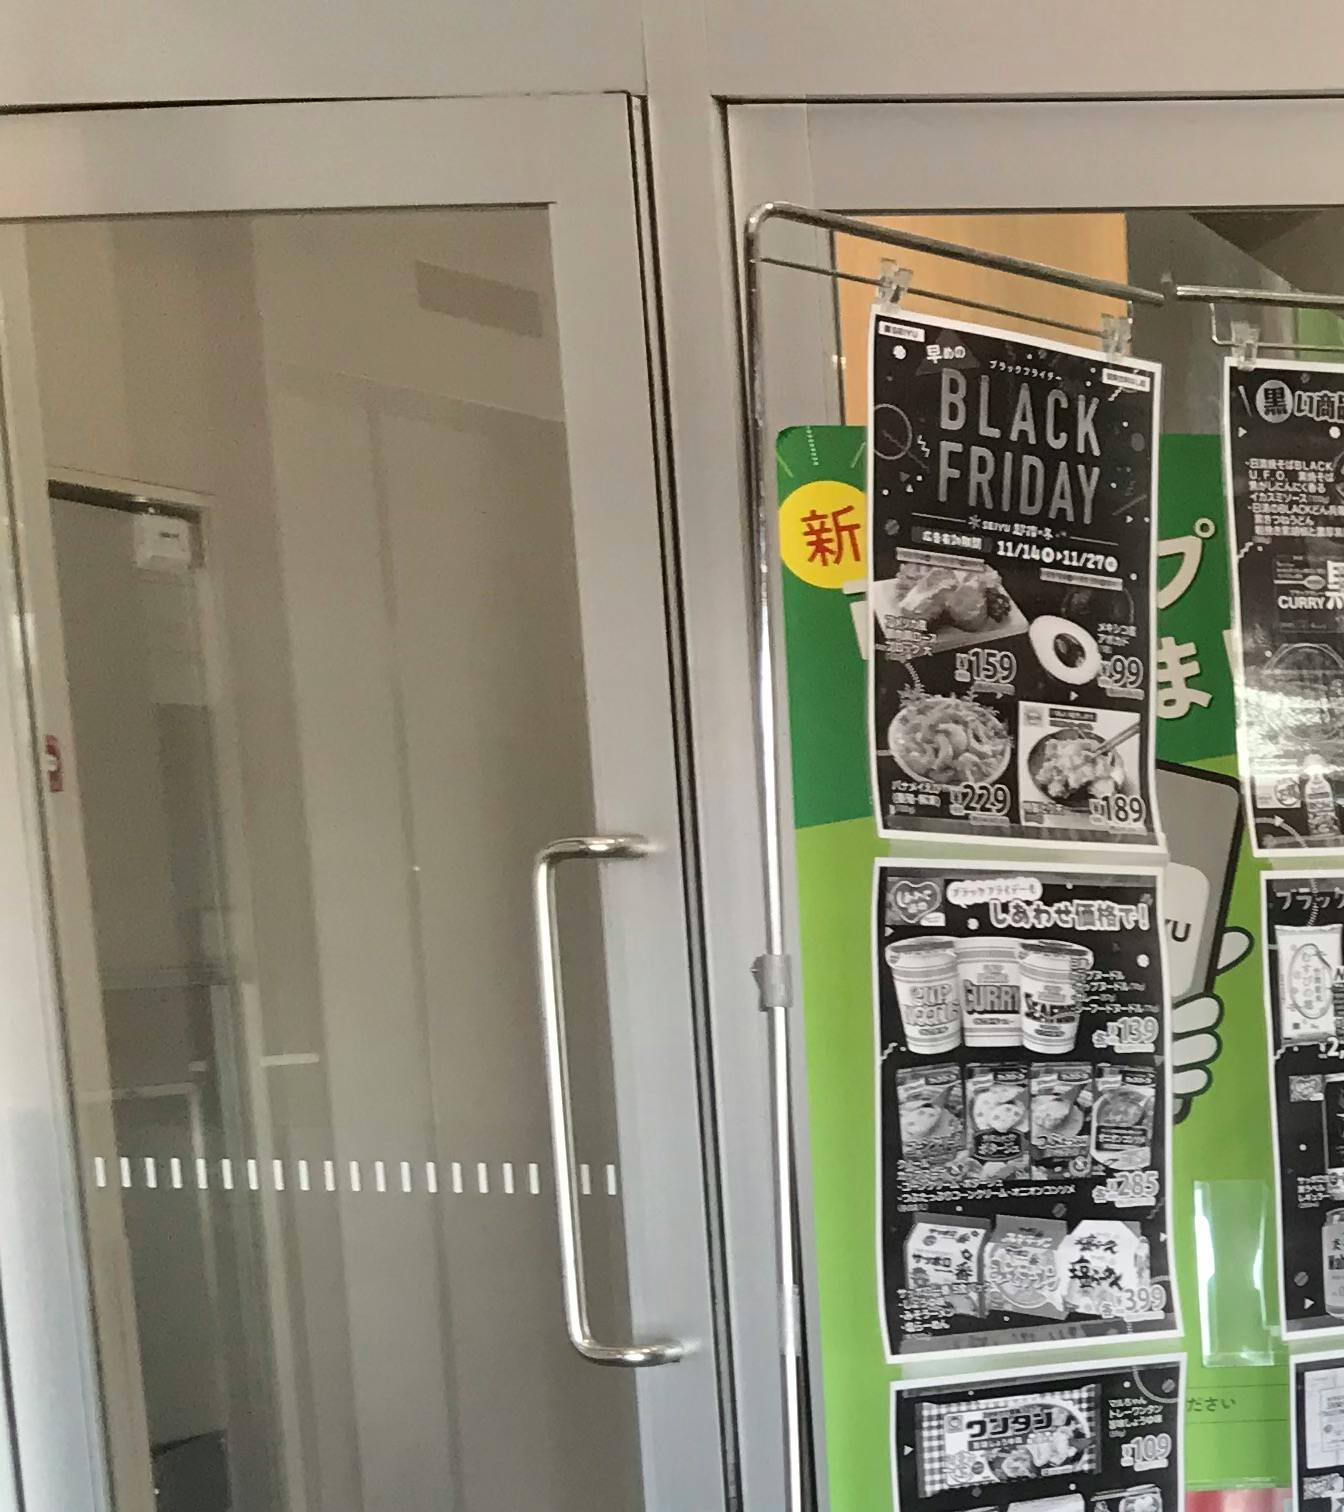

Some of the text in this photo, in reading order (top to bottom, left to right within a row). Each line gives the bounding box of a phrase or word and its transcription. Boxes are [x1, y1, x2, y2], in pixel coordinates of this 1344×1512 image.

[940, 367, 1101, 456] BLACK
[938, 440, 1100, 525] FRIDAY
[1278, 596, 1325, 610] CURRY
[966, 1411, 1053, 1438] ワンタン
